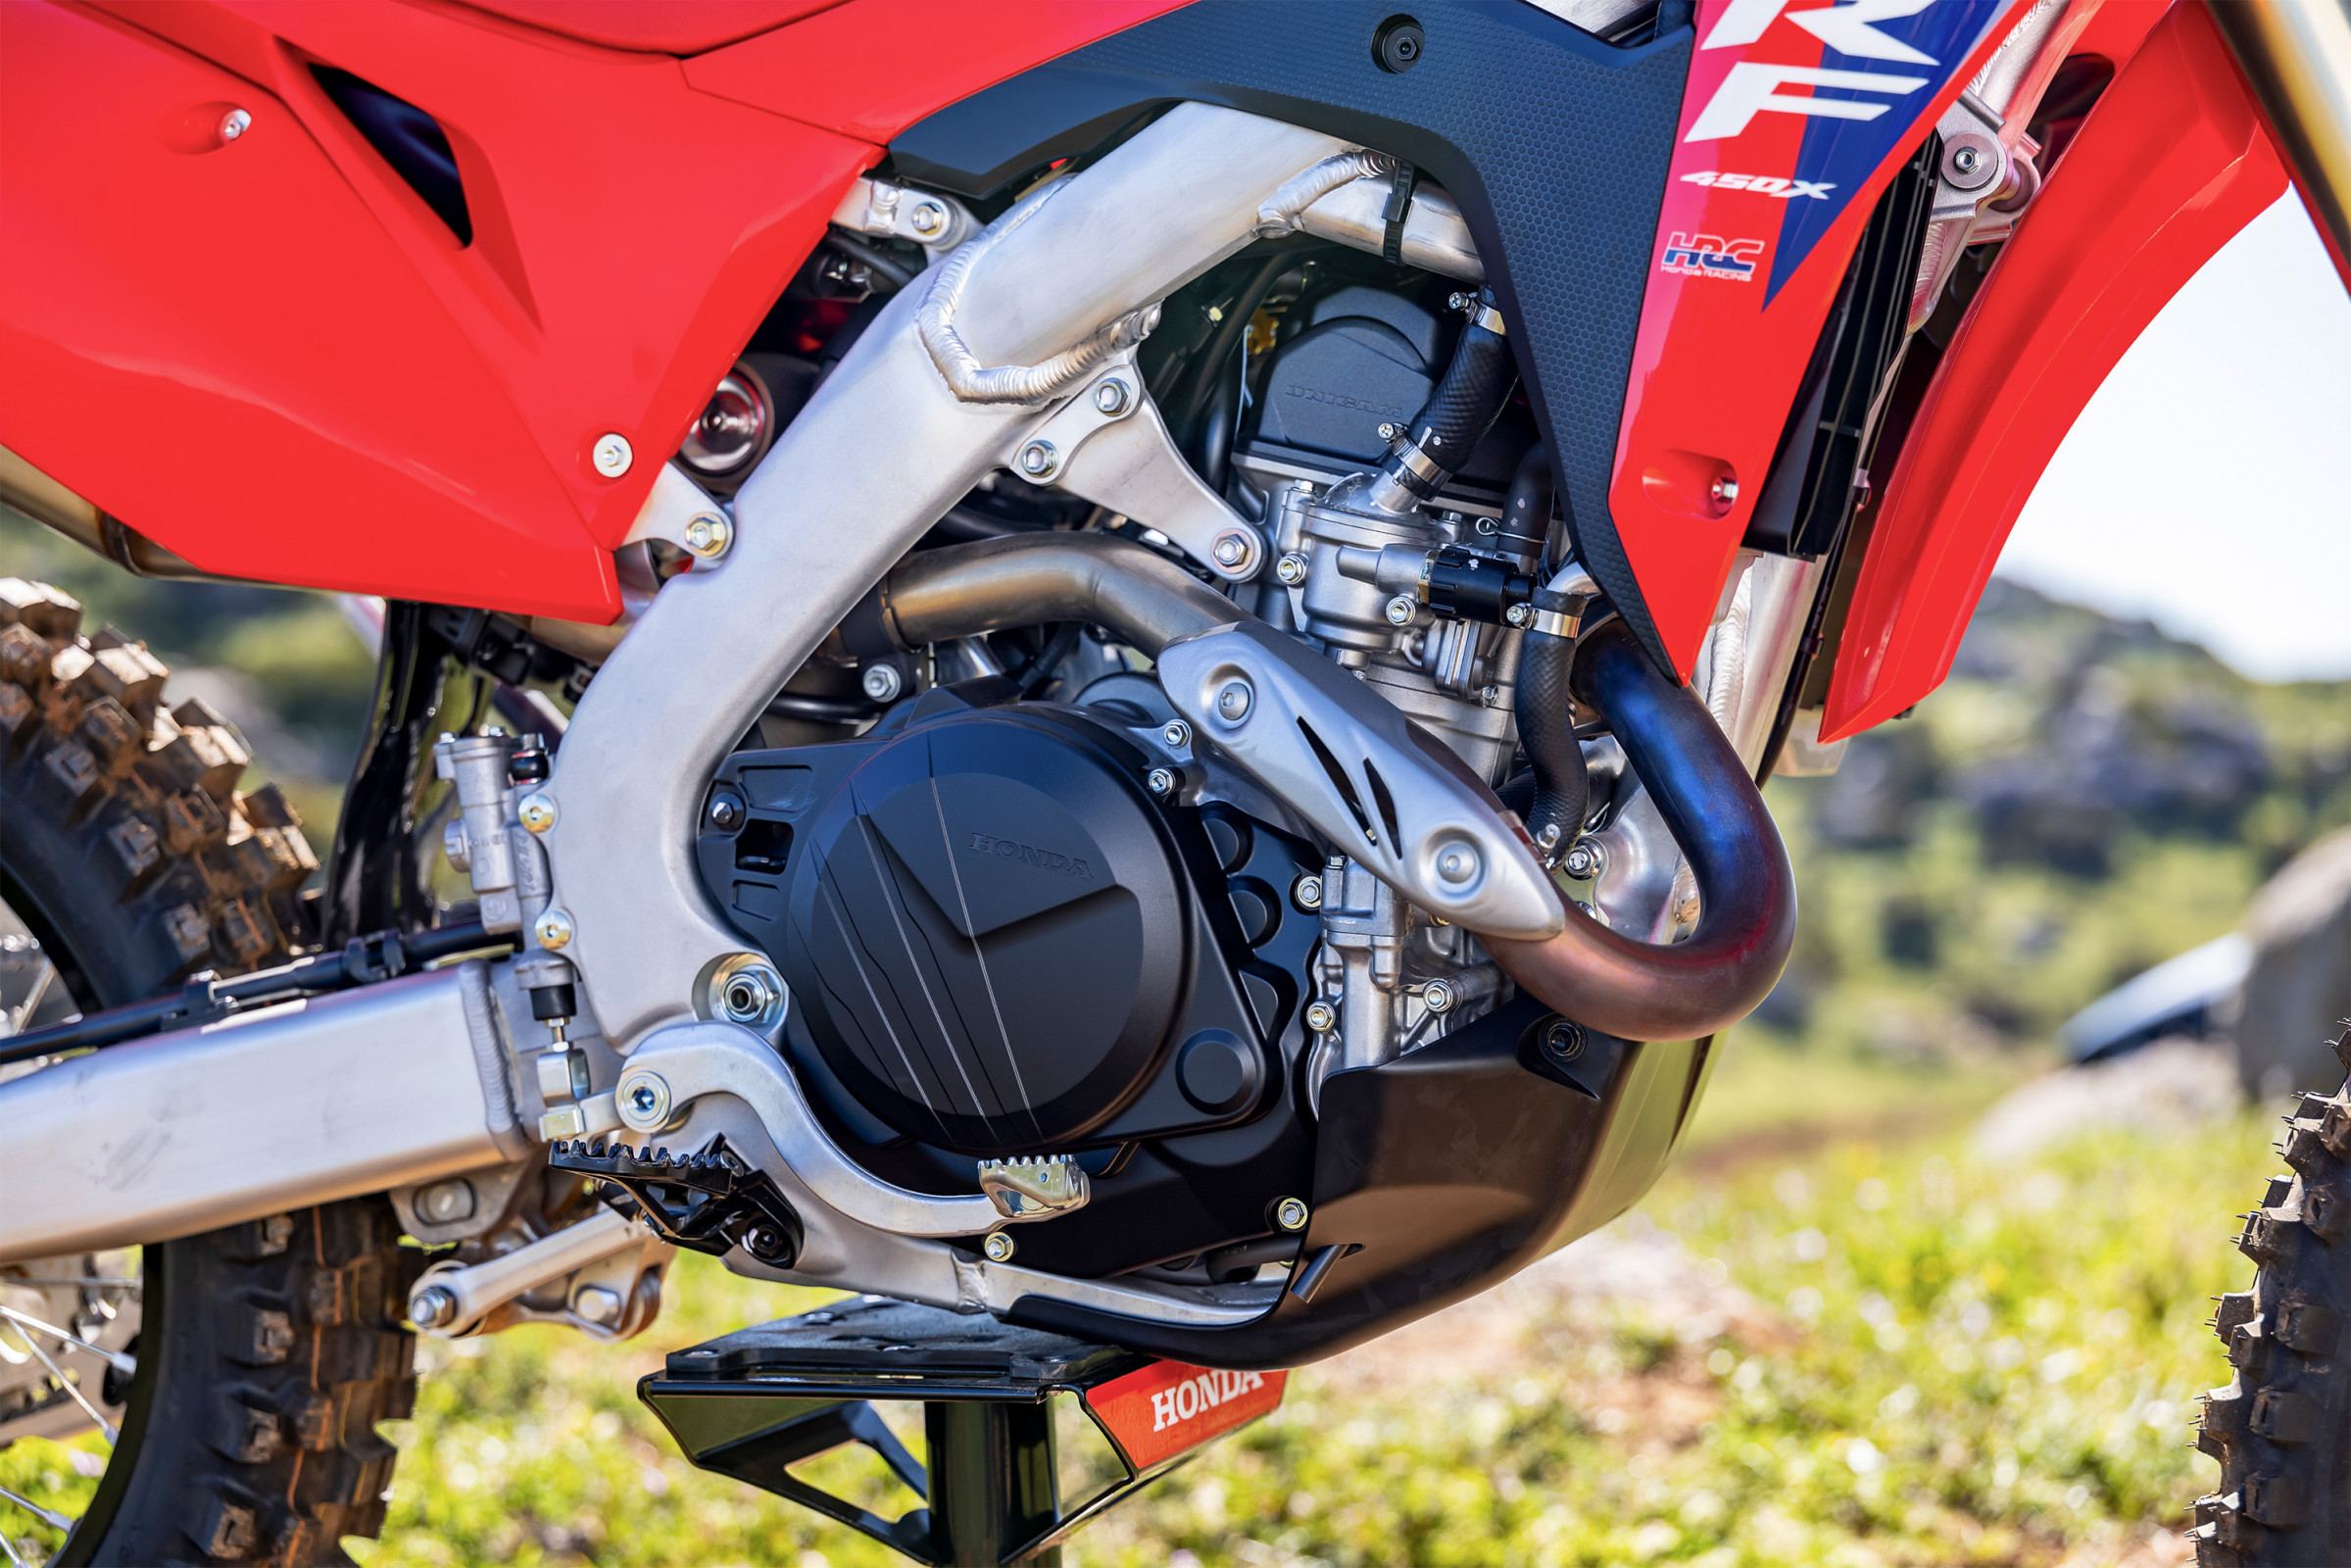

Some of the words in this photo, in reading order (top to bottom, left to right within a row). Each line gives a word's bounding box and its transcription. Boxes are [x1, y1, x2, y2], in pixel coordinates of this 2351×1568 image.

[1680, 171, 1837, 200] 450X
[1662, 231, 1765, 274] HRC
[1703, 269, 1752, 282] RACING
[1285, 384, 1402, 418] UNICAM
[969, 832, 1095, 878] HONDA
[1151, 1370, 1265, 1433] HONDA
